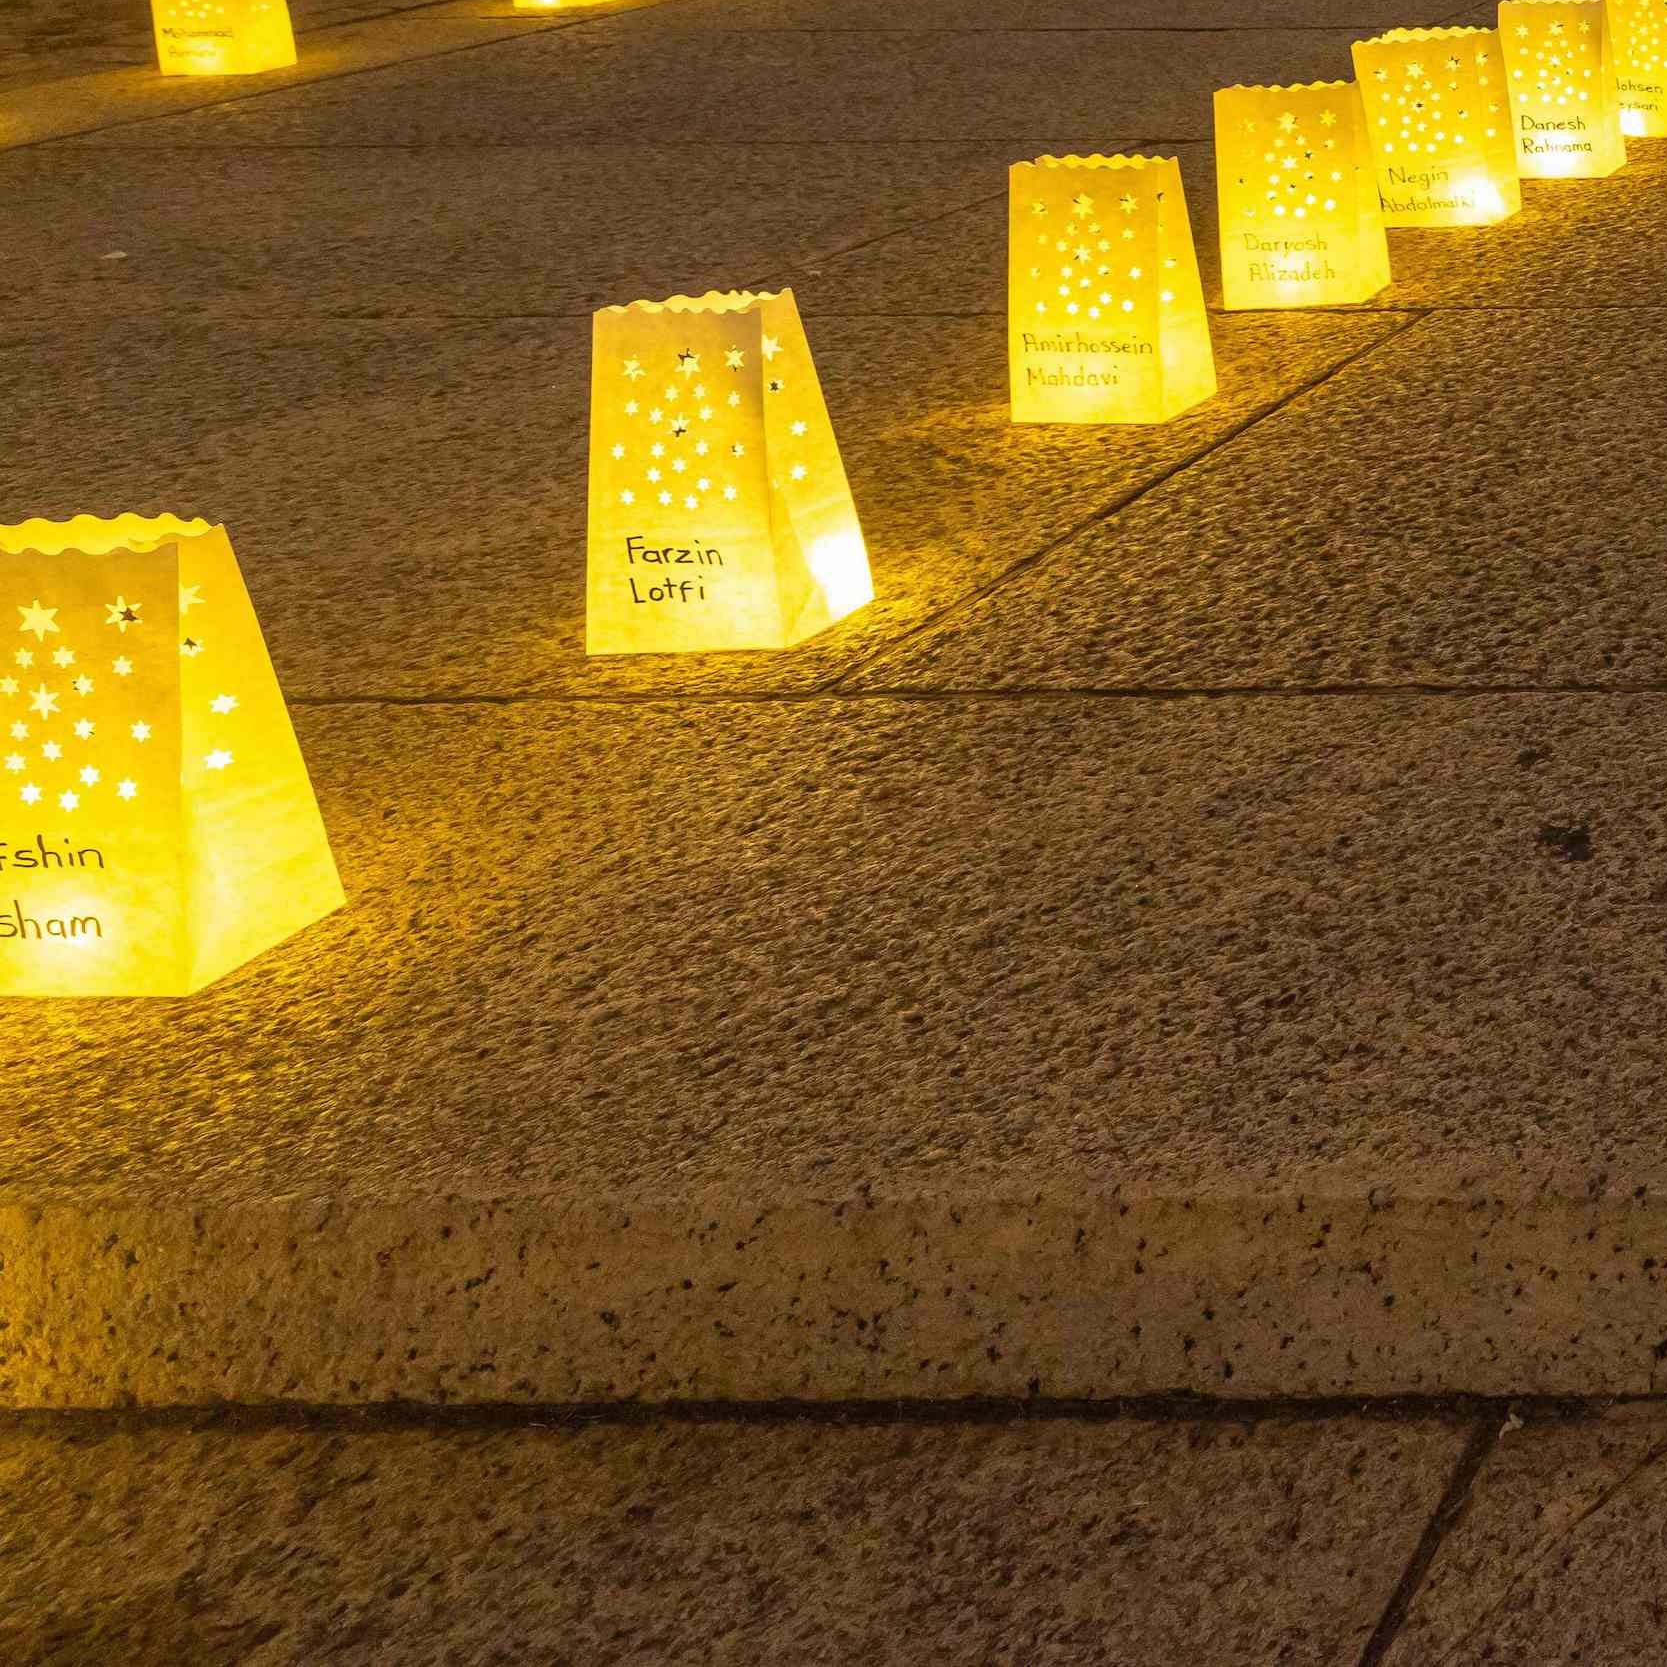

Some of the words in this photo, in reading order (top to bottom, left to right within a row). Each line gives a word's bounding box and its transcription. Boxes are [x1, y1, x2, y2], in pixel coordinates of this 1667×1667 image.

[1520, 114, 1587, 132] Danesh
[1387, 165, 1449, 191] Negin
[1248, 259, 1336, 282] Alizadeh
[1022, 332, 1153, 355] Amirhossein
[1026, 365, 1120, 387] Mahdavi
[625, 535, 724, 567] Farzin
[628, 574, 705, 604] Lotfi
[0, 833, 105, 871] fshin
[0, 899, 103, 939] sham
